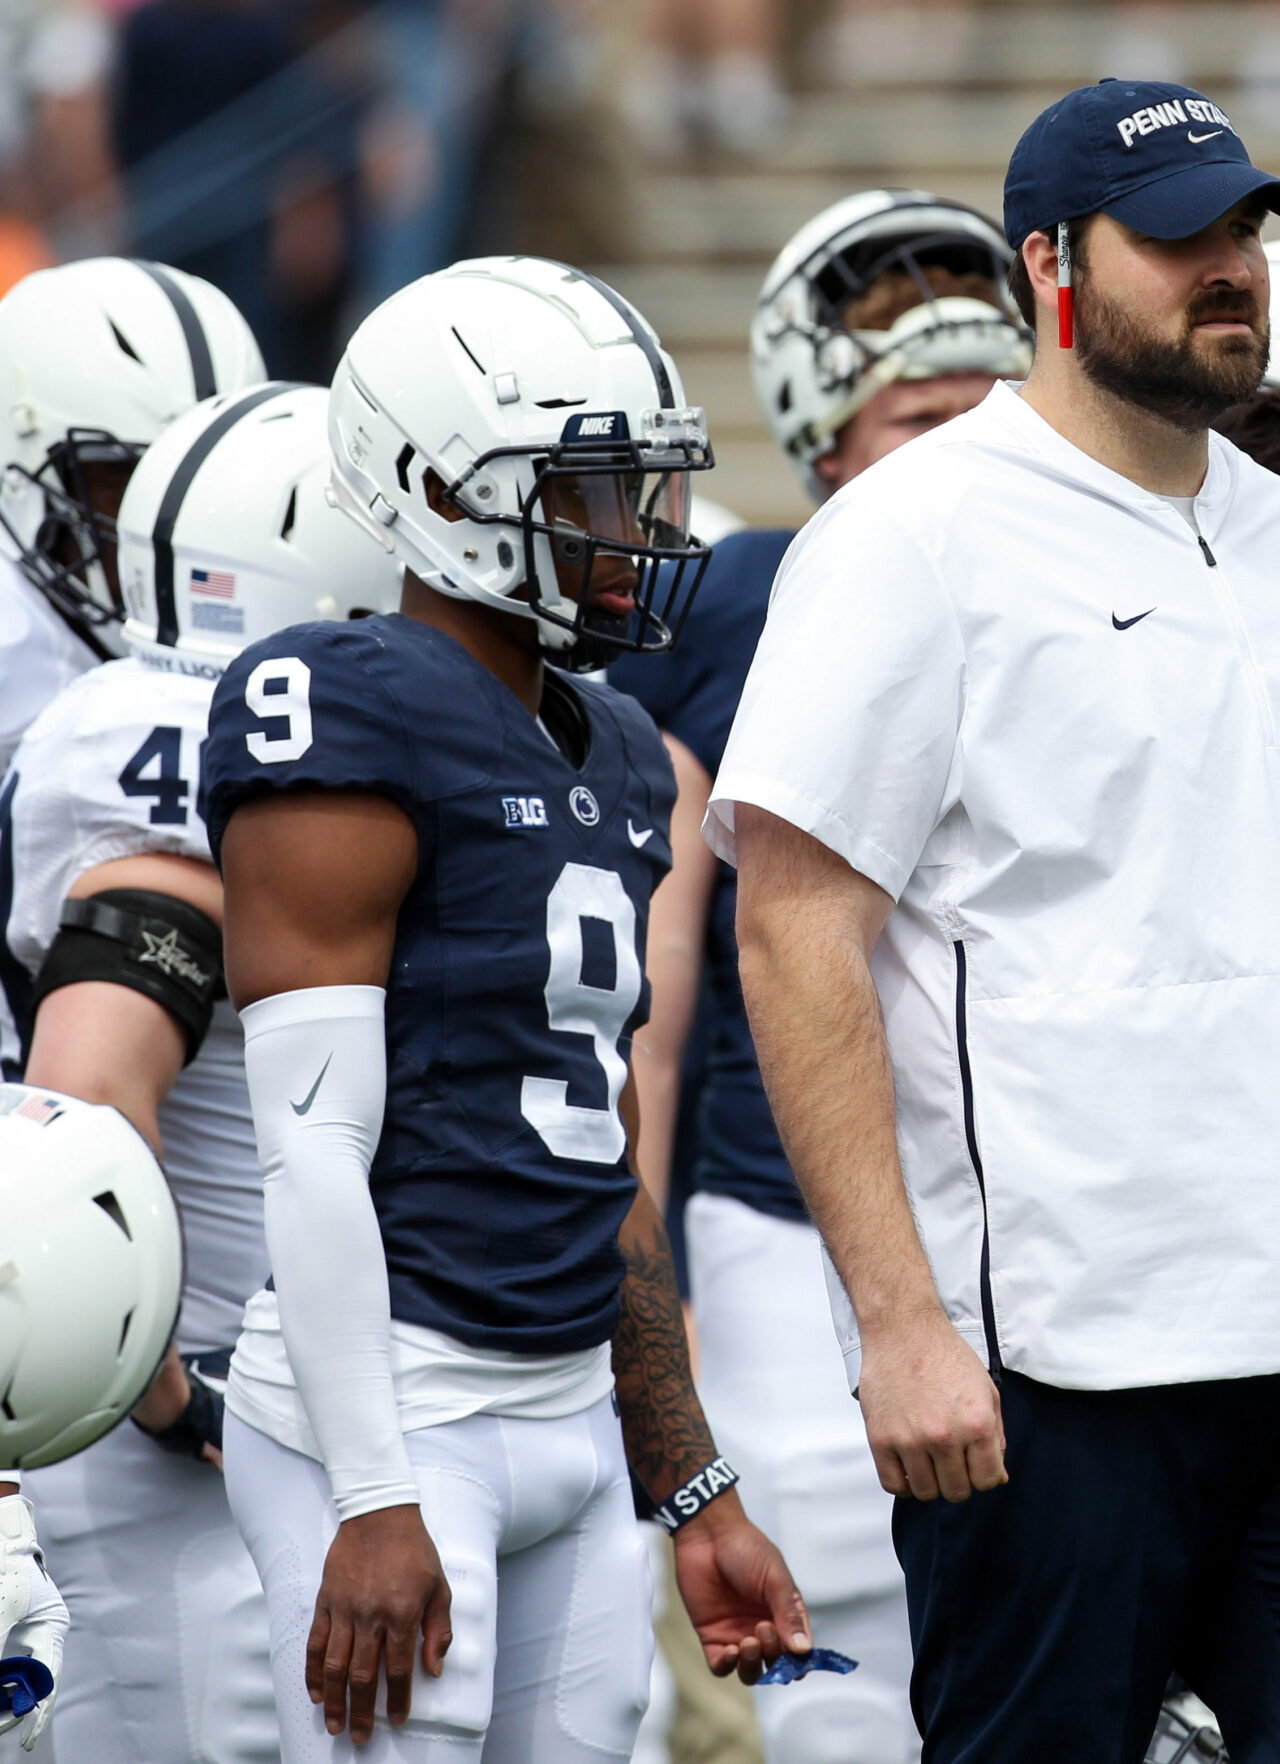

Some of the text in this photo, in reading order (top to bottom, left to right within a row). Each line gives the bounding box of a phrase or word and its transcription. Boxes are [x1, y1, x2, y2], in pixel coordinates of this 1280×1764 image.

[1116, 99, 1189, 148] PENN
[1059, 234, 1070, 270] Sharpie
[578, 416, 616, 436] NIKE
[245, 656, 314, 765] 9
[520, 861, 641, 1165] 9
